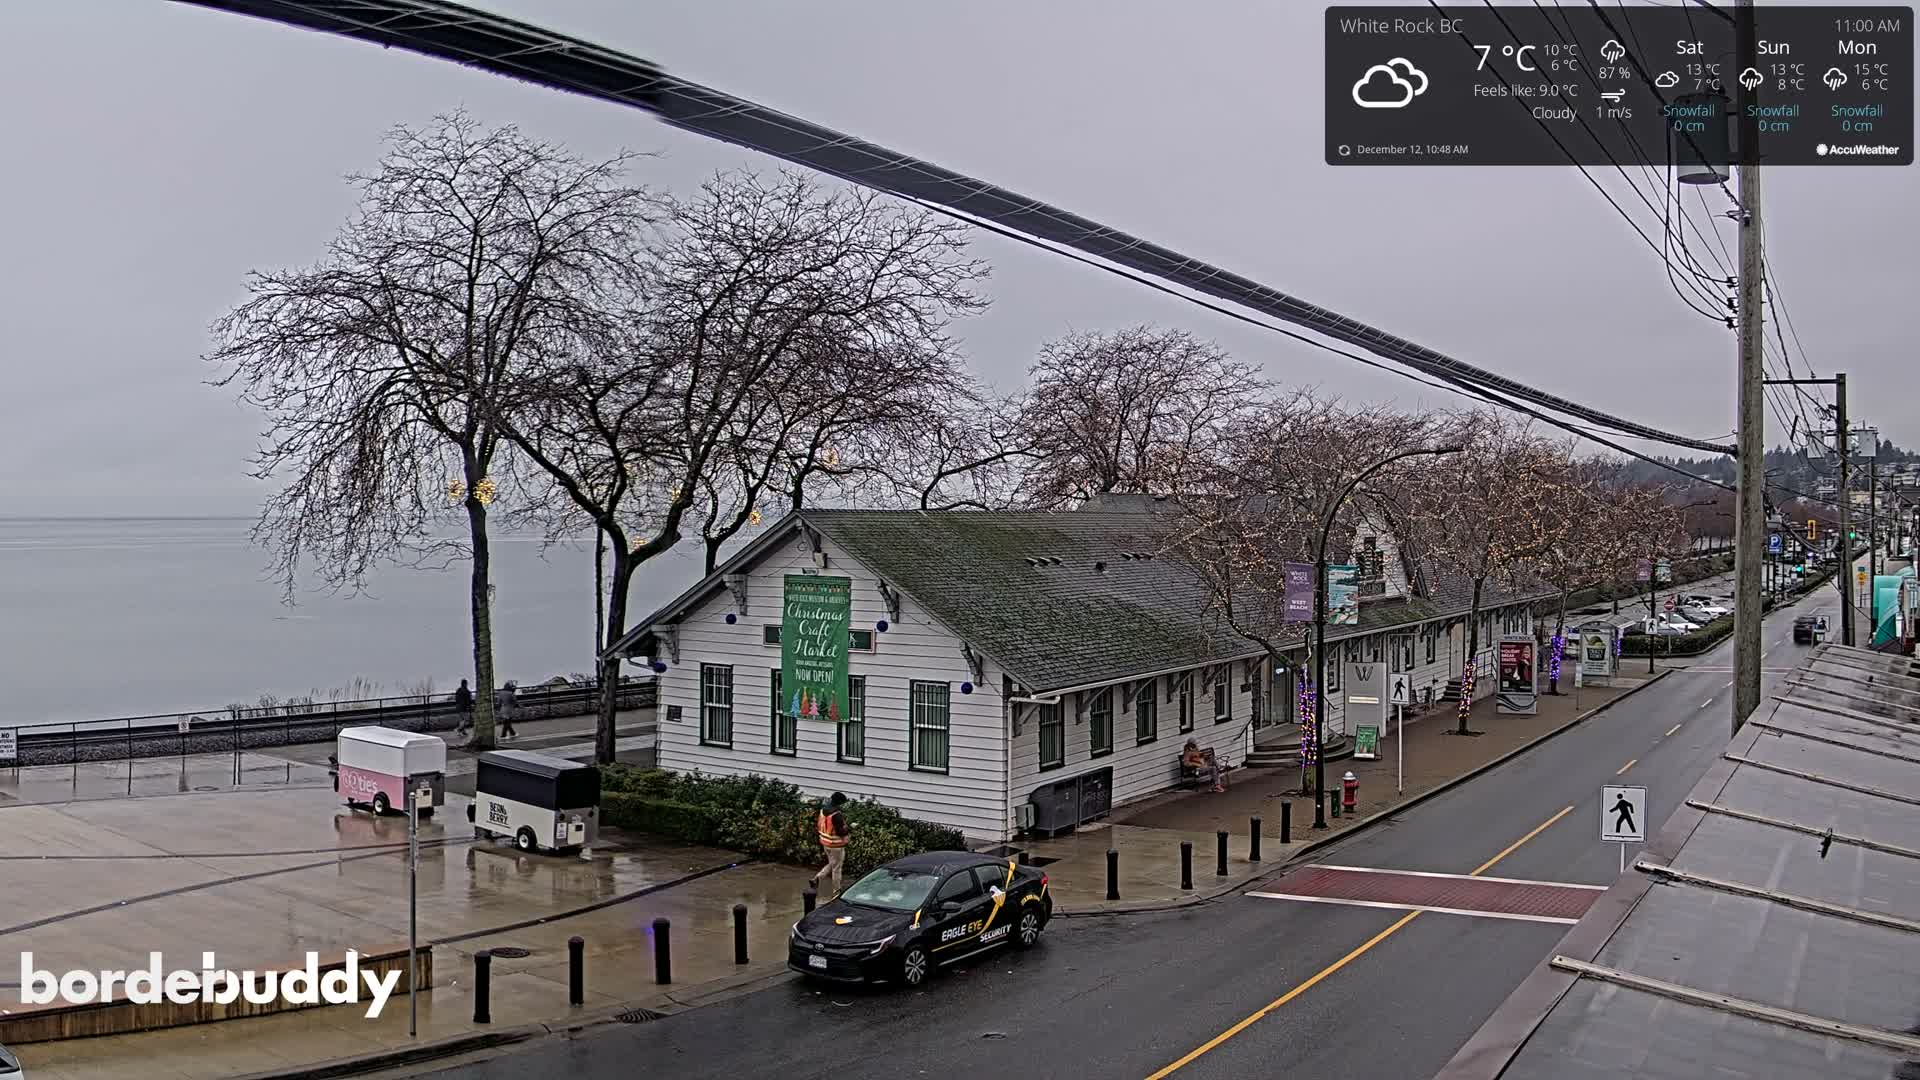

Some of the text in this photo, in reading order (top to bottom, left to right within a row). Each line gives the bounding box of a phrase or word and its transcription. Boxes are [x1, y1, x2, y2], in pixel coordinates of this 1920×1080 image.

[787, 602, 845, 621] Christmas
[799, 619, 830, 646] Craft
[792, 638, 839, 658] Market
[795, 668, 834, 684] NOW OPEN!
[941, 919, 983, 942] EAGLE EYE
[979, 924, 1012, 942] SECURITY
